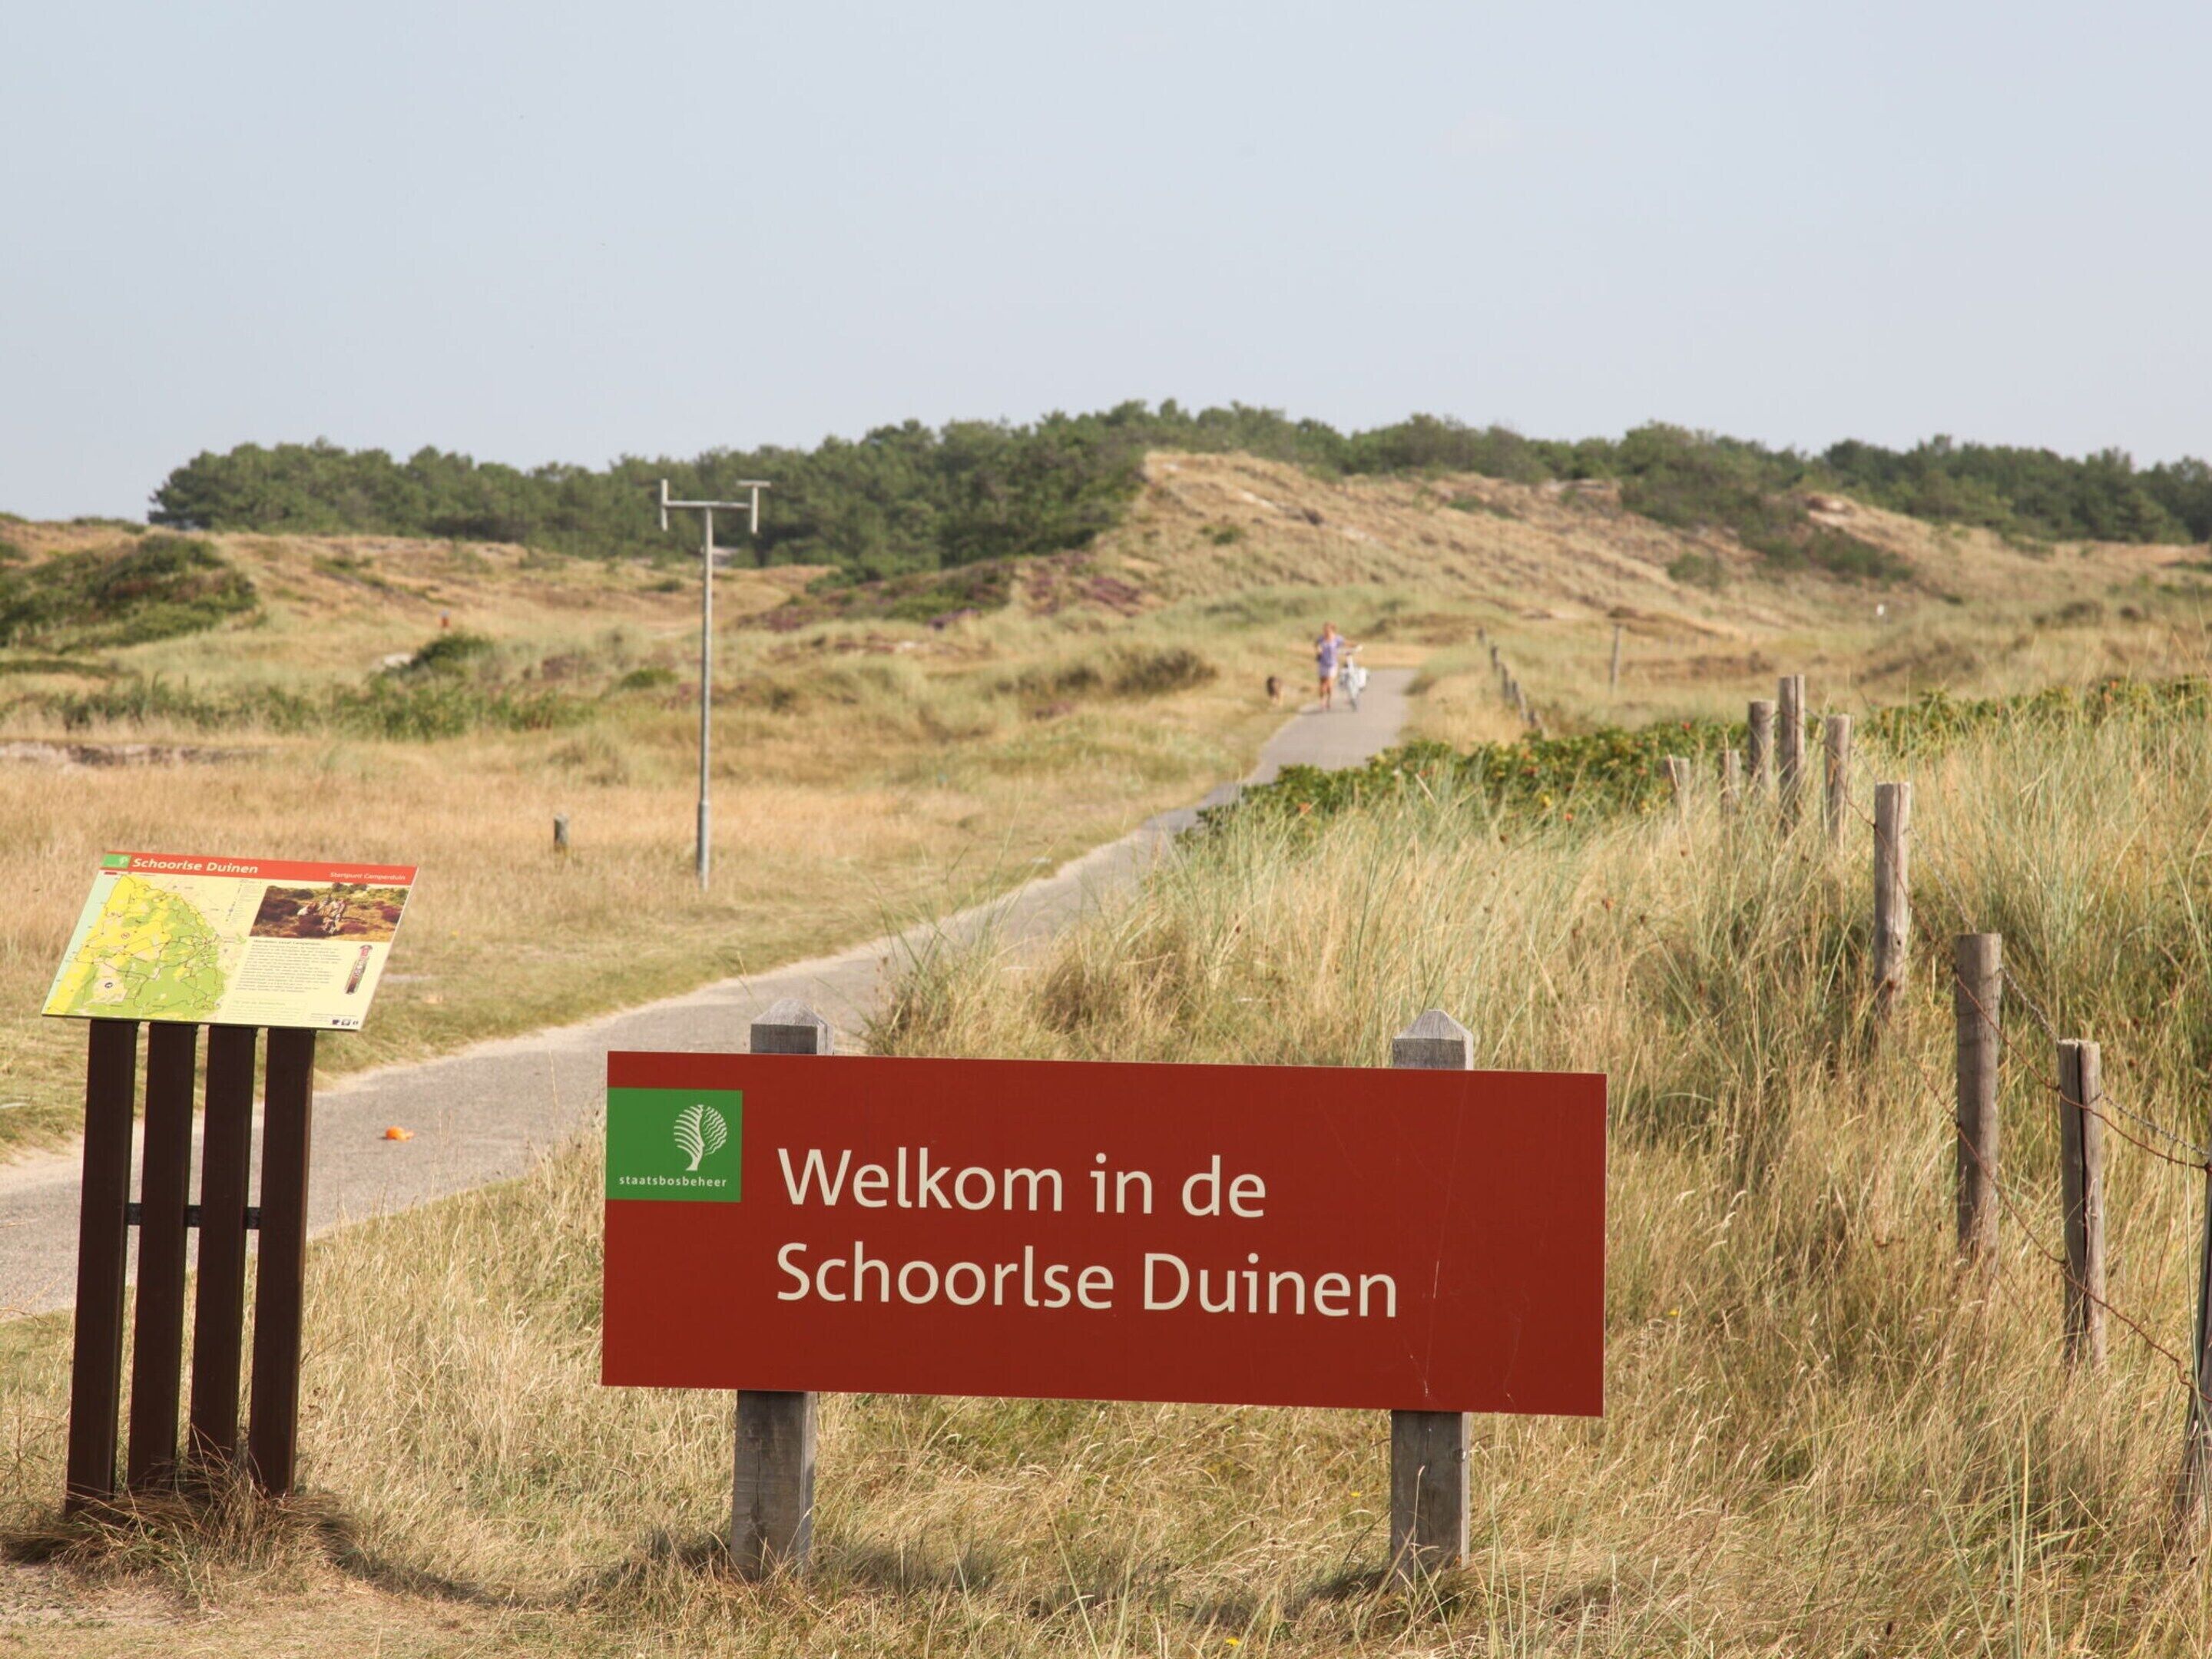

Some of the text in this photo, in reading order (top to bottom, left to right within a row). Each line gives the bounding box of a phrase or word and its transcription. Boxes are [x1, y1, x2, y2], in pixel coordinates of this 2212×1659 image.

[132, 858, 259, 874] Schoorlse Duinen
[619, 1175, 727, 1187] staatsbosbeheer
[777, 1146, 1266, 1218] Welkom in de
[777, 1240, 1396, 1318] Schoorlse Duinen
